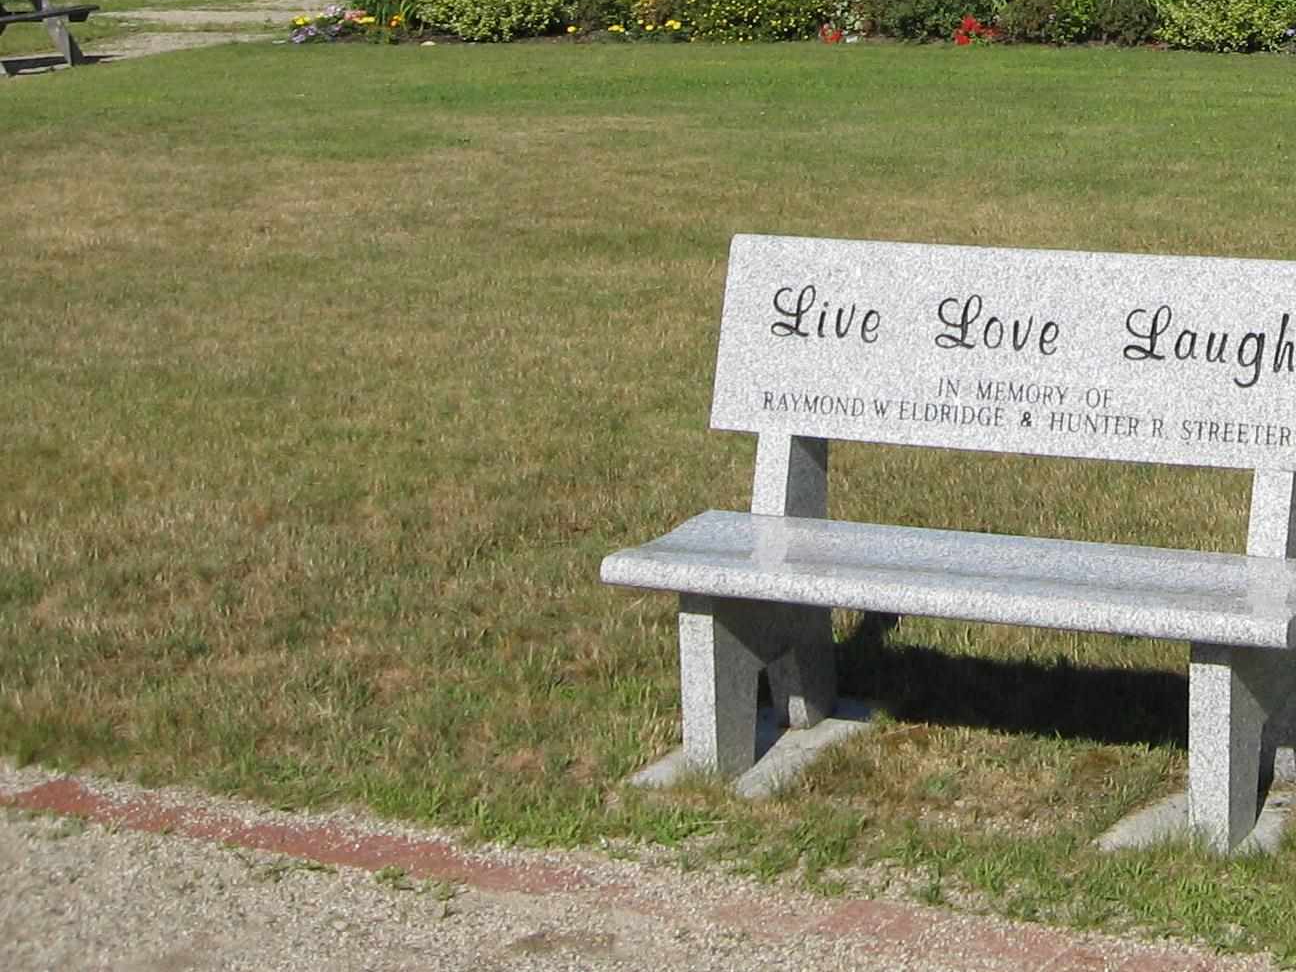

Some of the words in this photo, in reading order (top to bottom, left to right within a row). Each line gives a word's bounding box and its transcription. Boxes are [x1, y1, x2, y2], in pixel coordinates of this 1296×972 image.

[770, 284, 881, 343] Live
[934, 294, 1060, 356] Love
[1122, 305, 1296, 389] Laugh
[762, 391, 865, 418] RAYMOND
[898, 400, 1005, 428] ELDRIDGE
[1020, 412, 1032, 428] &
[1049, 412, 1139, 438] HUNTER
[1180, 419, 1292, 447] STREETER
[936, 378, 960, 399] IN
[975, 380, 1070, 406] MEMORY
[1084, 387, 1114, 409] OF
